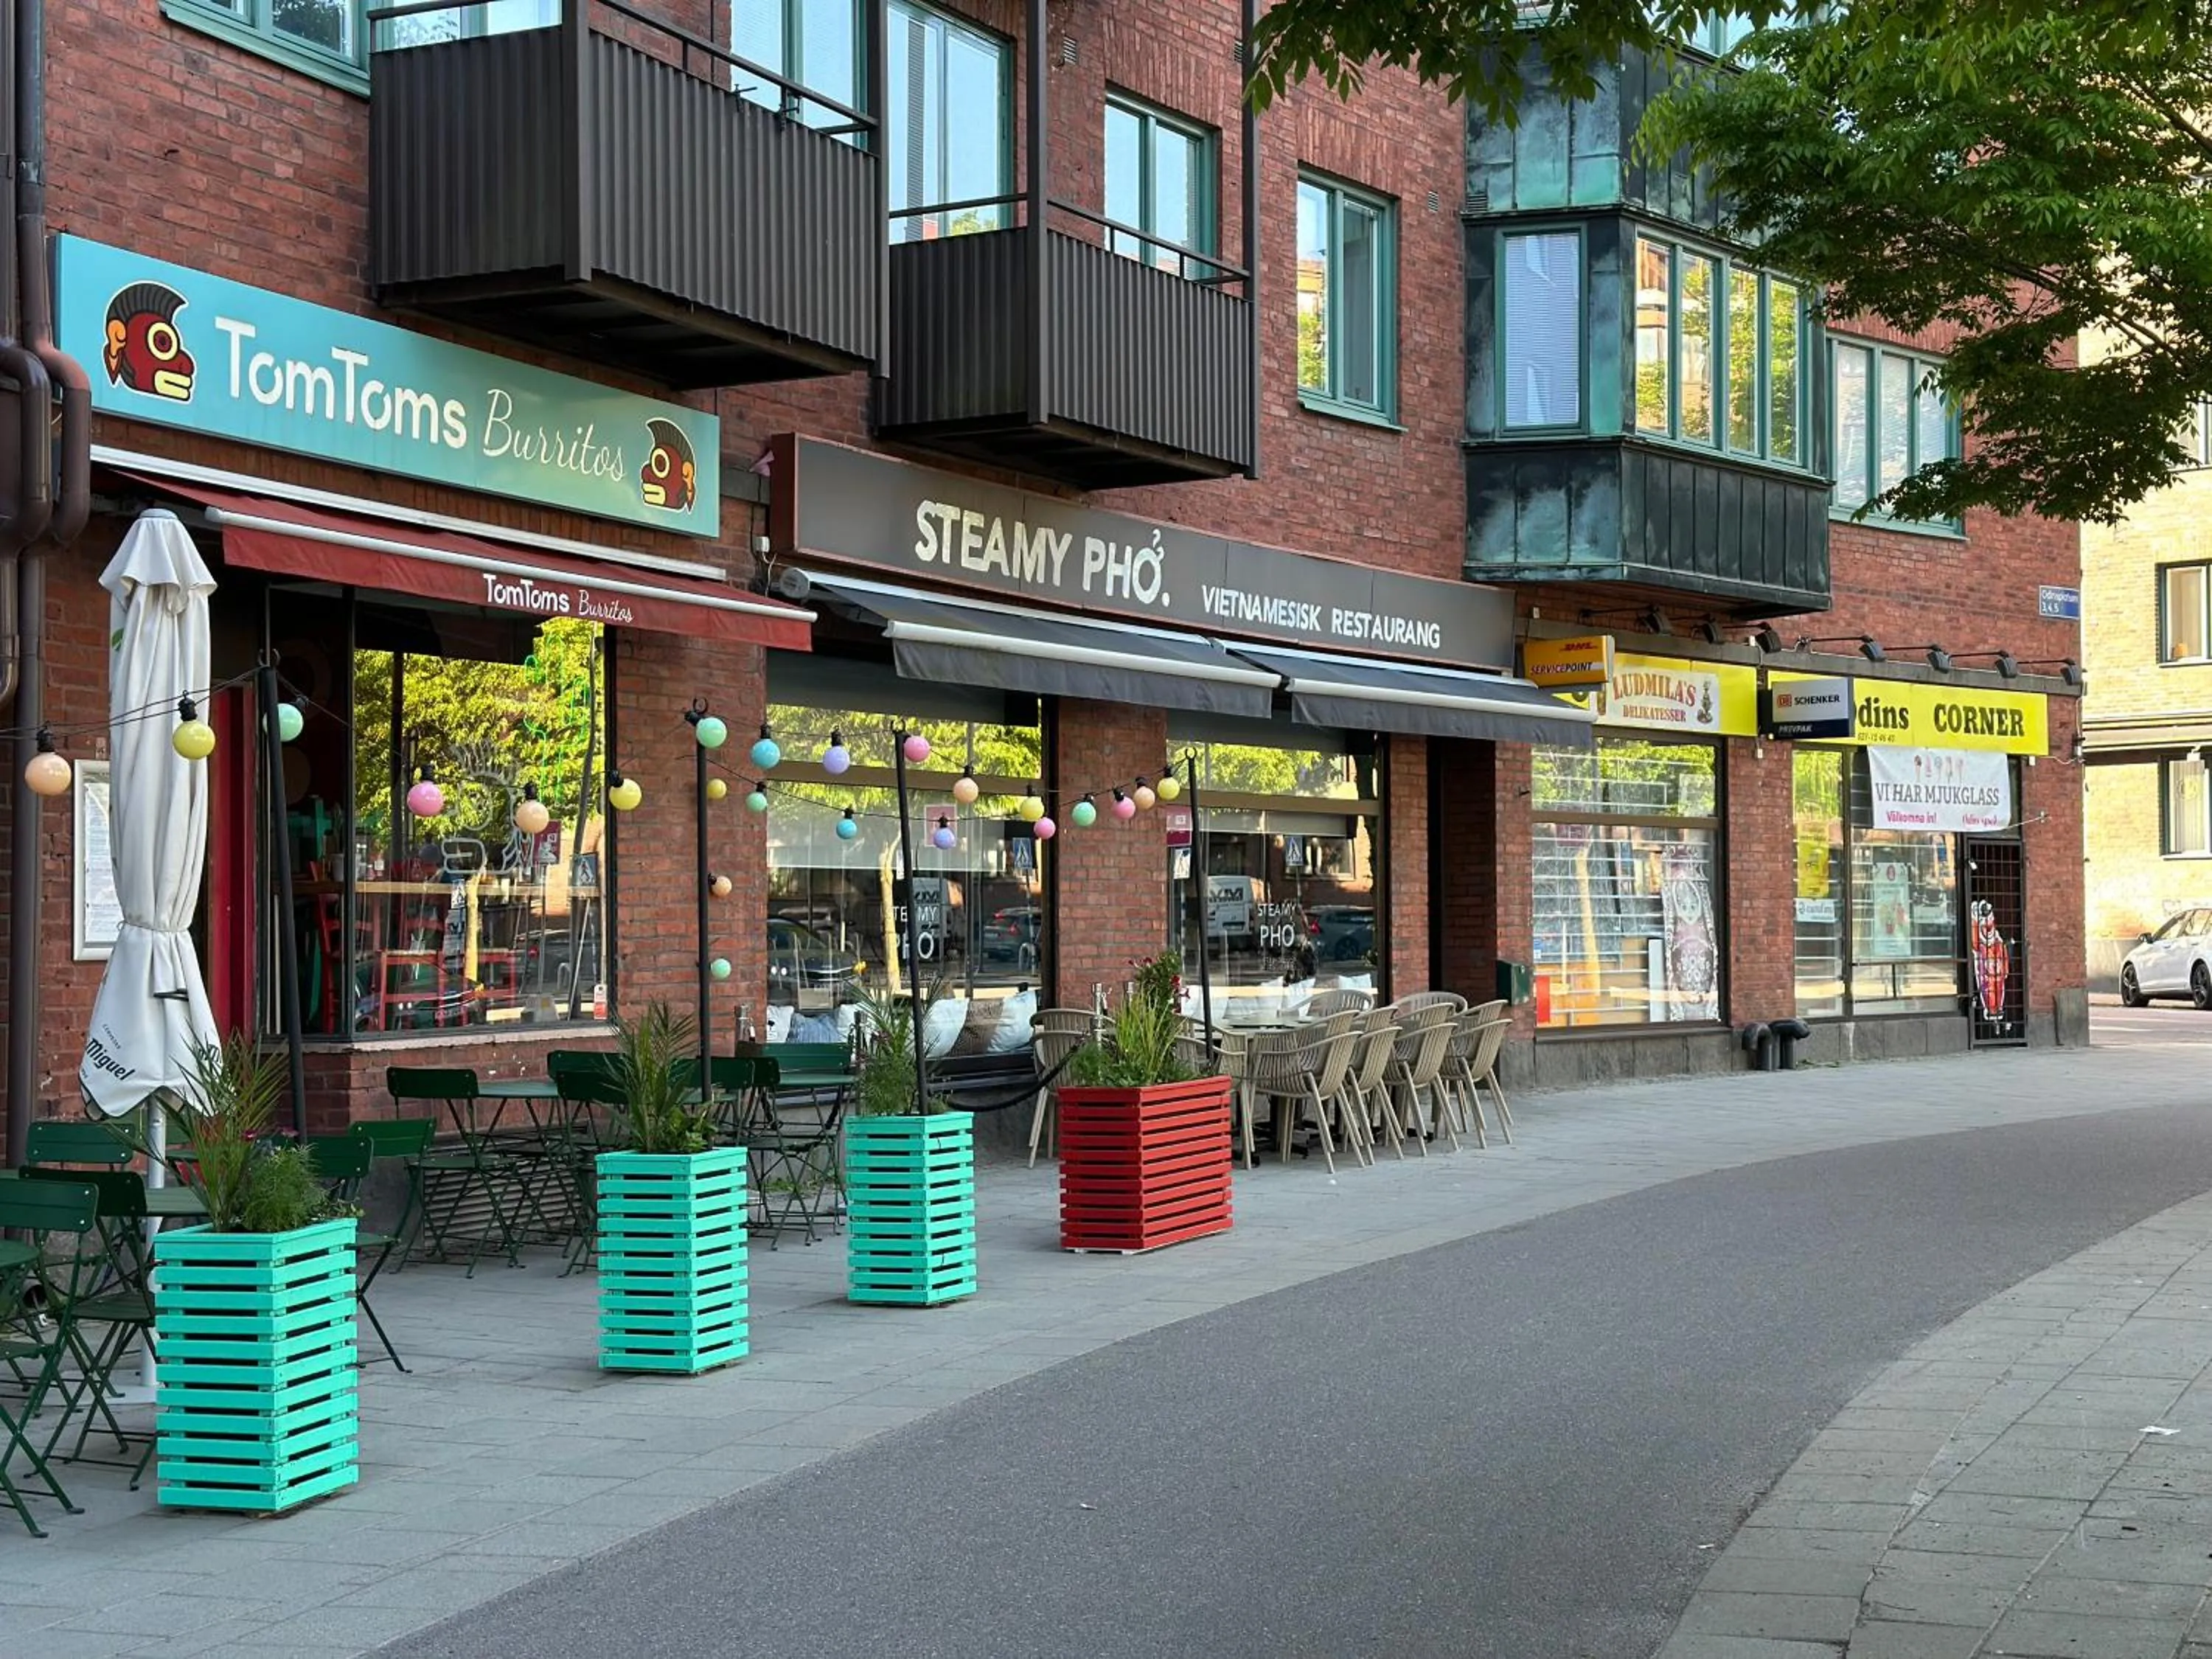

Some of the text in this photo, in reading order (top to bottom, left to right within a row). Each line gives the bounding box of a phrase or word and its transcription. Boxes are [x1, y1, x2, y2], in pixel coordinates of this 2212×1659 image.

[215, 316, 627, 481] TomToms Burritos
[915, 499, 1074, 587] STEAMY
[484, 573, 633, 624] TomToms Burritos
[1202, 585, 1441, 650] VIETNAMESISK RESTAURANG
[1531, 661, 1593, 676] SERVICEPOINT
[1613, 672, 1697, 707] LUDMILA'S
[1794, 694, 1840, 706] SCHENKER
[1854, 697, 2025, 737] dins CORNER
[1875, 782, 2000, 806] VI HAR MJUKGLASS
[1257, 902, 1297, 919] STEAMY
[86, 1037, 136, 1081] Miguel
